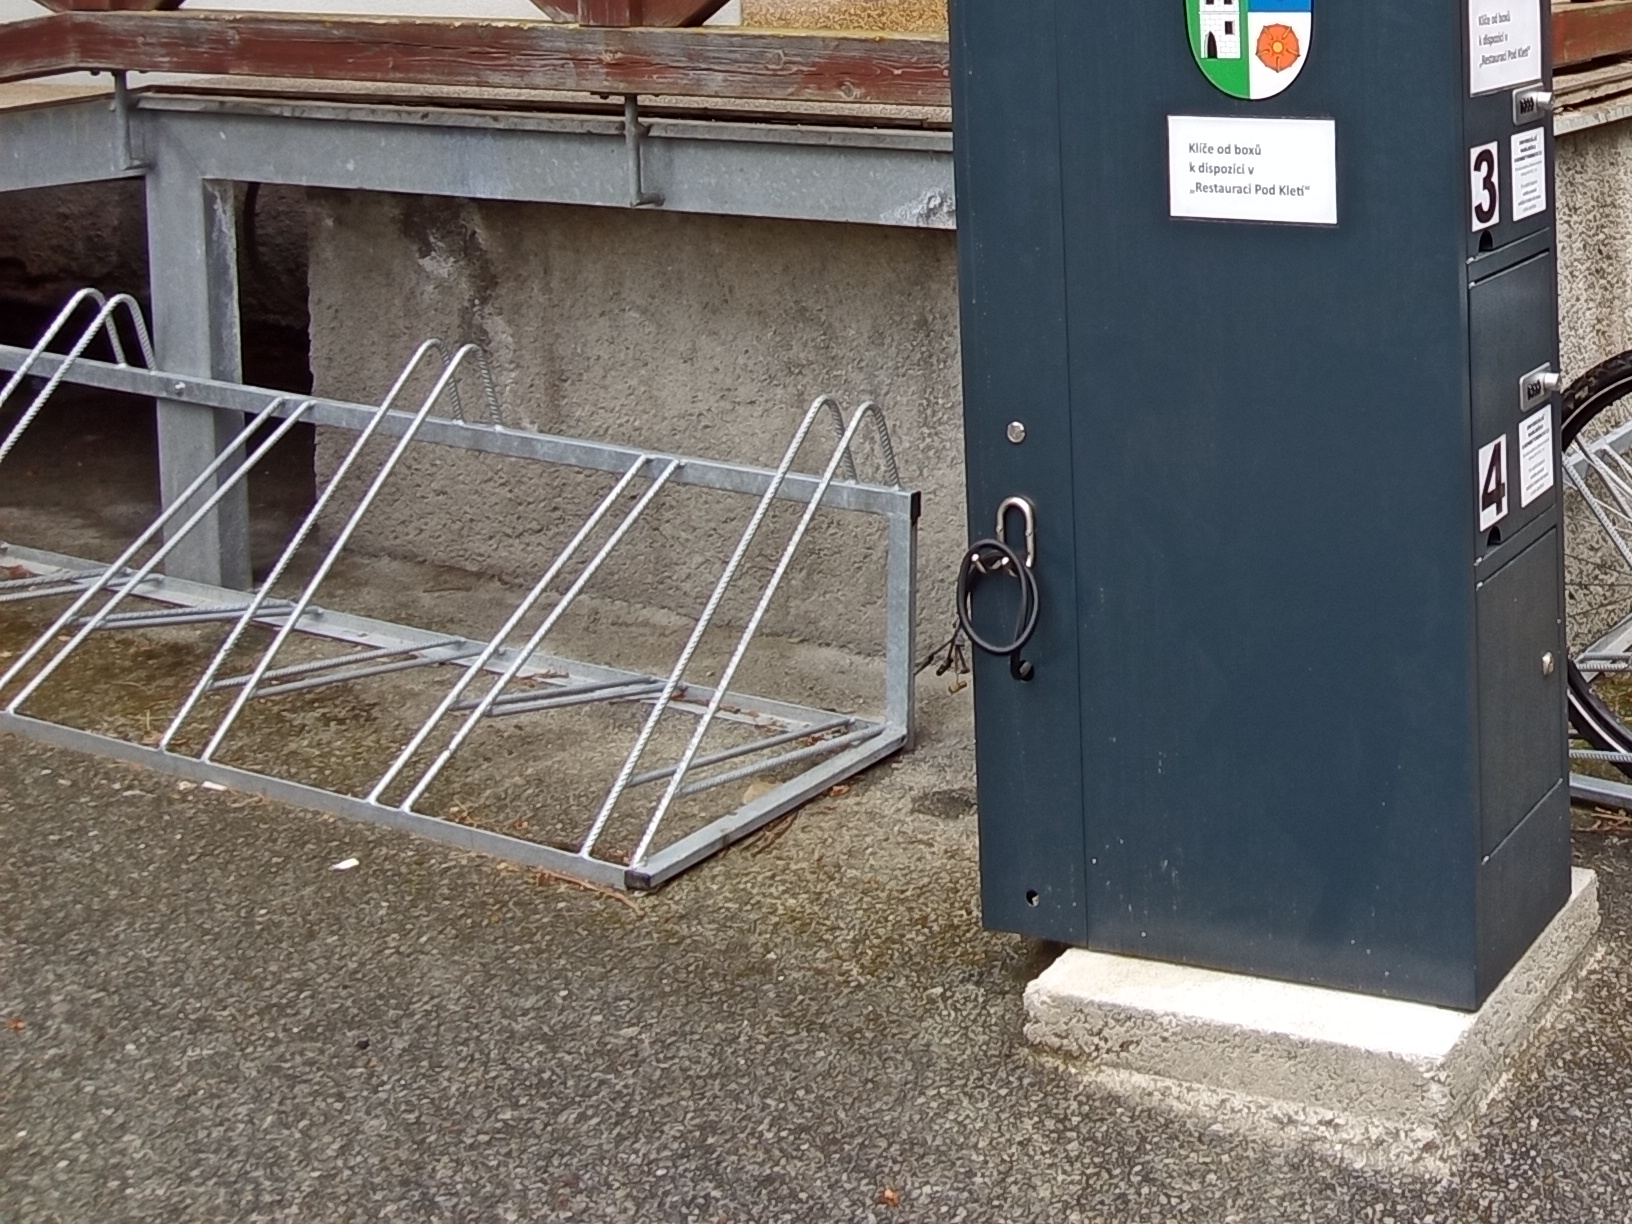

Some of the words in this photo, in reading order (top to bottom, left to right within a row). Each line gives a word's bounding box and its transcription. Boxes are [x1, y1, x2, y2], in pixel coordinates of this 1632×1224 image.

[1188, 142, 1214, 154] Klíče
[1217, 143, 1231, 154] od
[1234, 143, 1262, 155] boxů
[1189, 161, 1196, 173] k
[1198, 162, 1245, 176] dispozici
[1248, 166, 1254, 175] v
[1255, 184, 1275, 195] Pod
[1474, 149, 1497, 223] 3
[1482, 441, 1505, 516] 4
